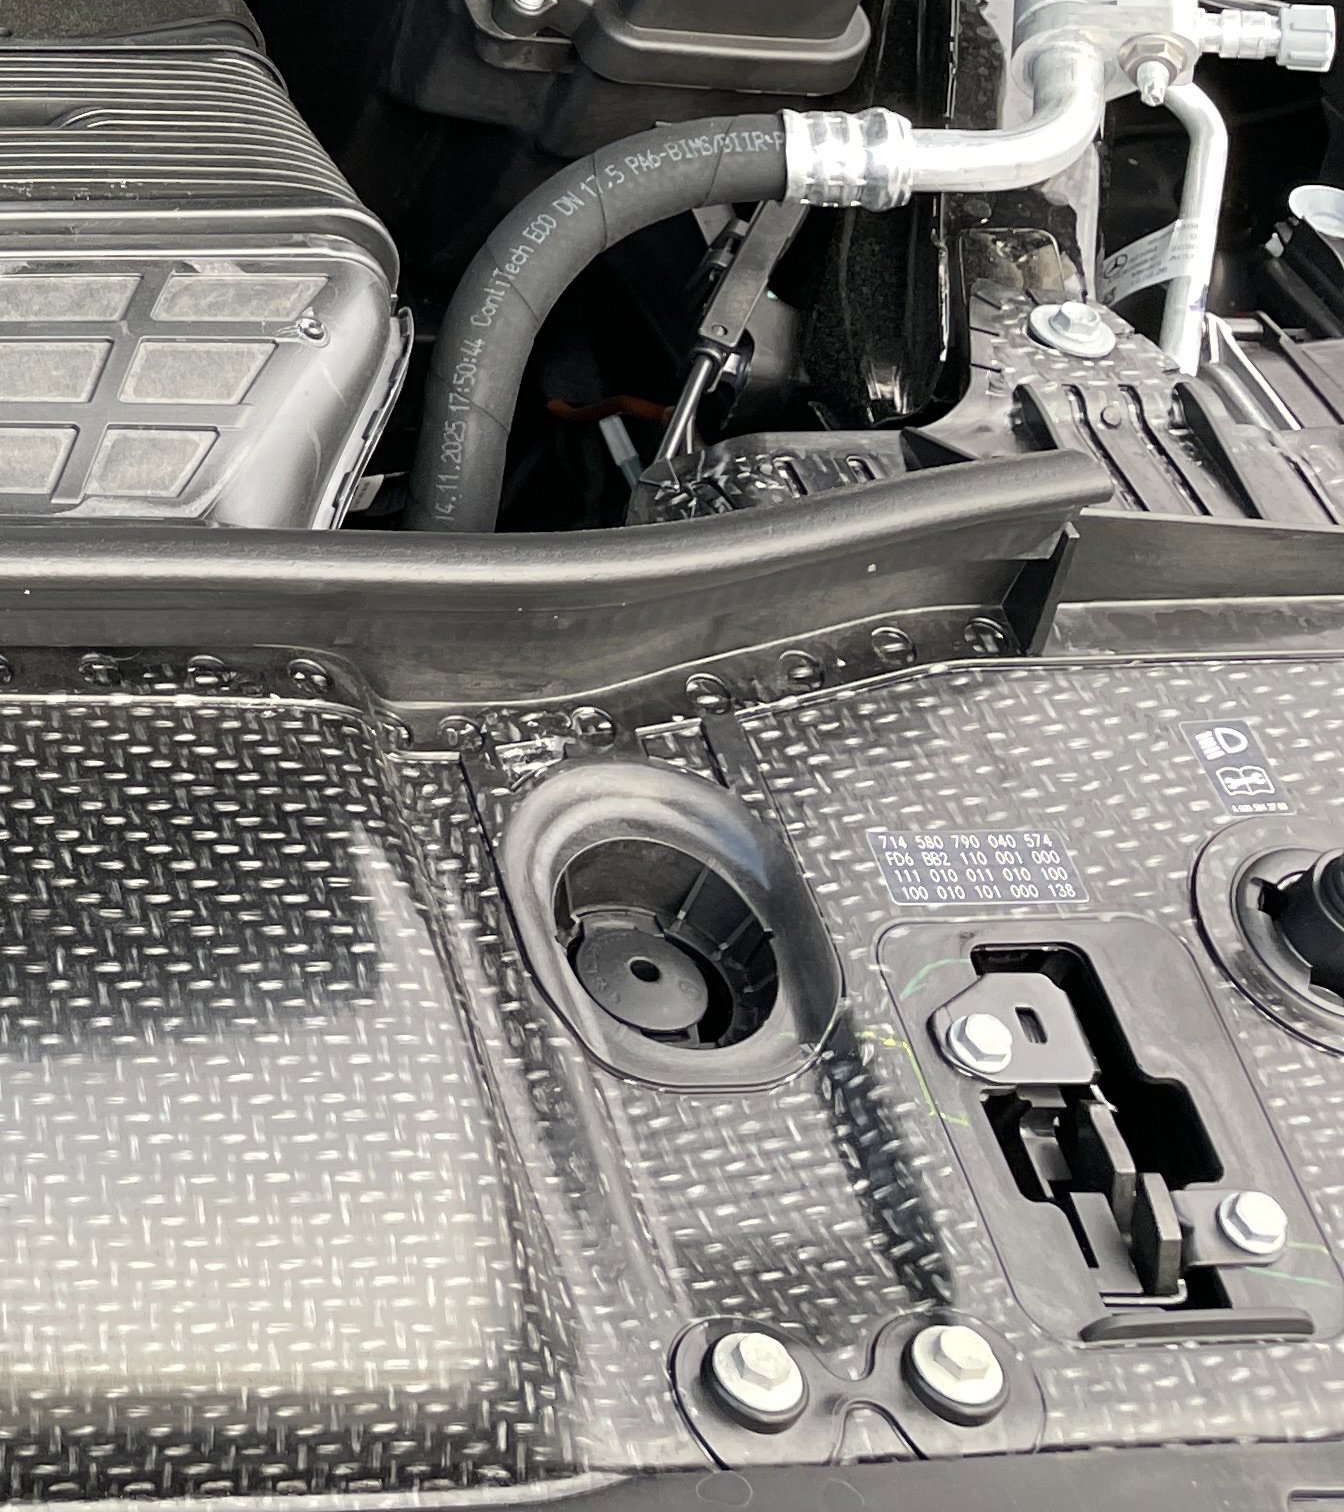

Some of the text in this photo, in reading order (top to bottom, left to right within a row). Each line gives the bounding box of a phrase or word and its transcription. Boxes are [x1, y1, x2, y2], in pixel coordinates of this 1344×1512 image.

[448, 338, 485, 411] 17:50:44
[470, 244, 534, 327] ContiTech
[552, 190, 585, 216] DN
[579, 164, 625, 198] 17.5
[878, 834, 1053, 849] 714 580 790 040 574
[885, 850, 1060, 866] FD6 BB2 110 001 000
[894, 867, 1068, 882] 111 010 011 010 100
[902, 883, 1076, 900] 100 010 101 000 138
